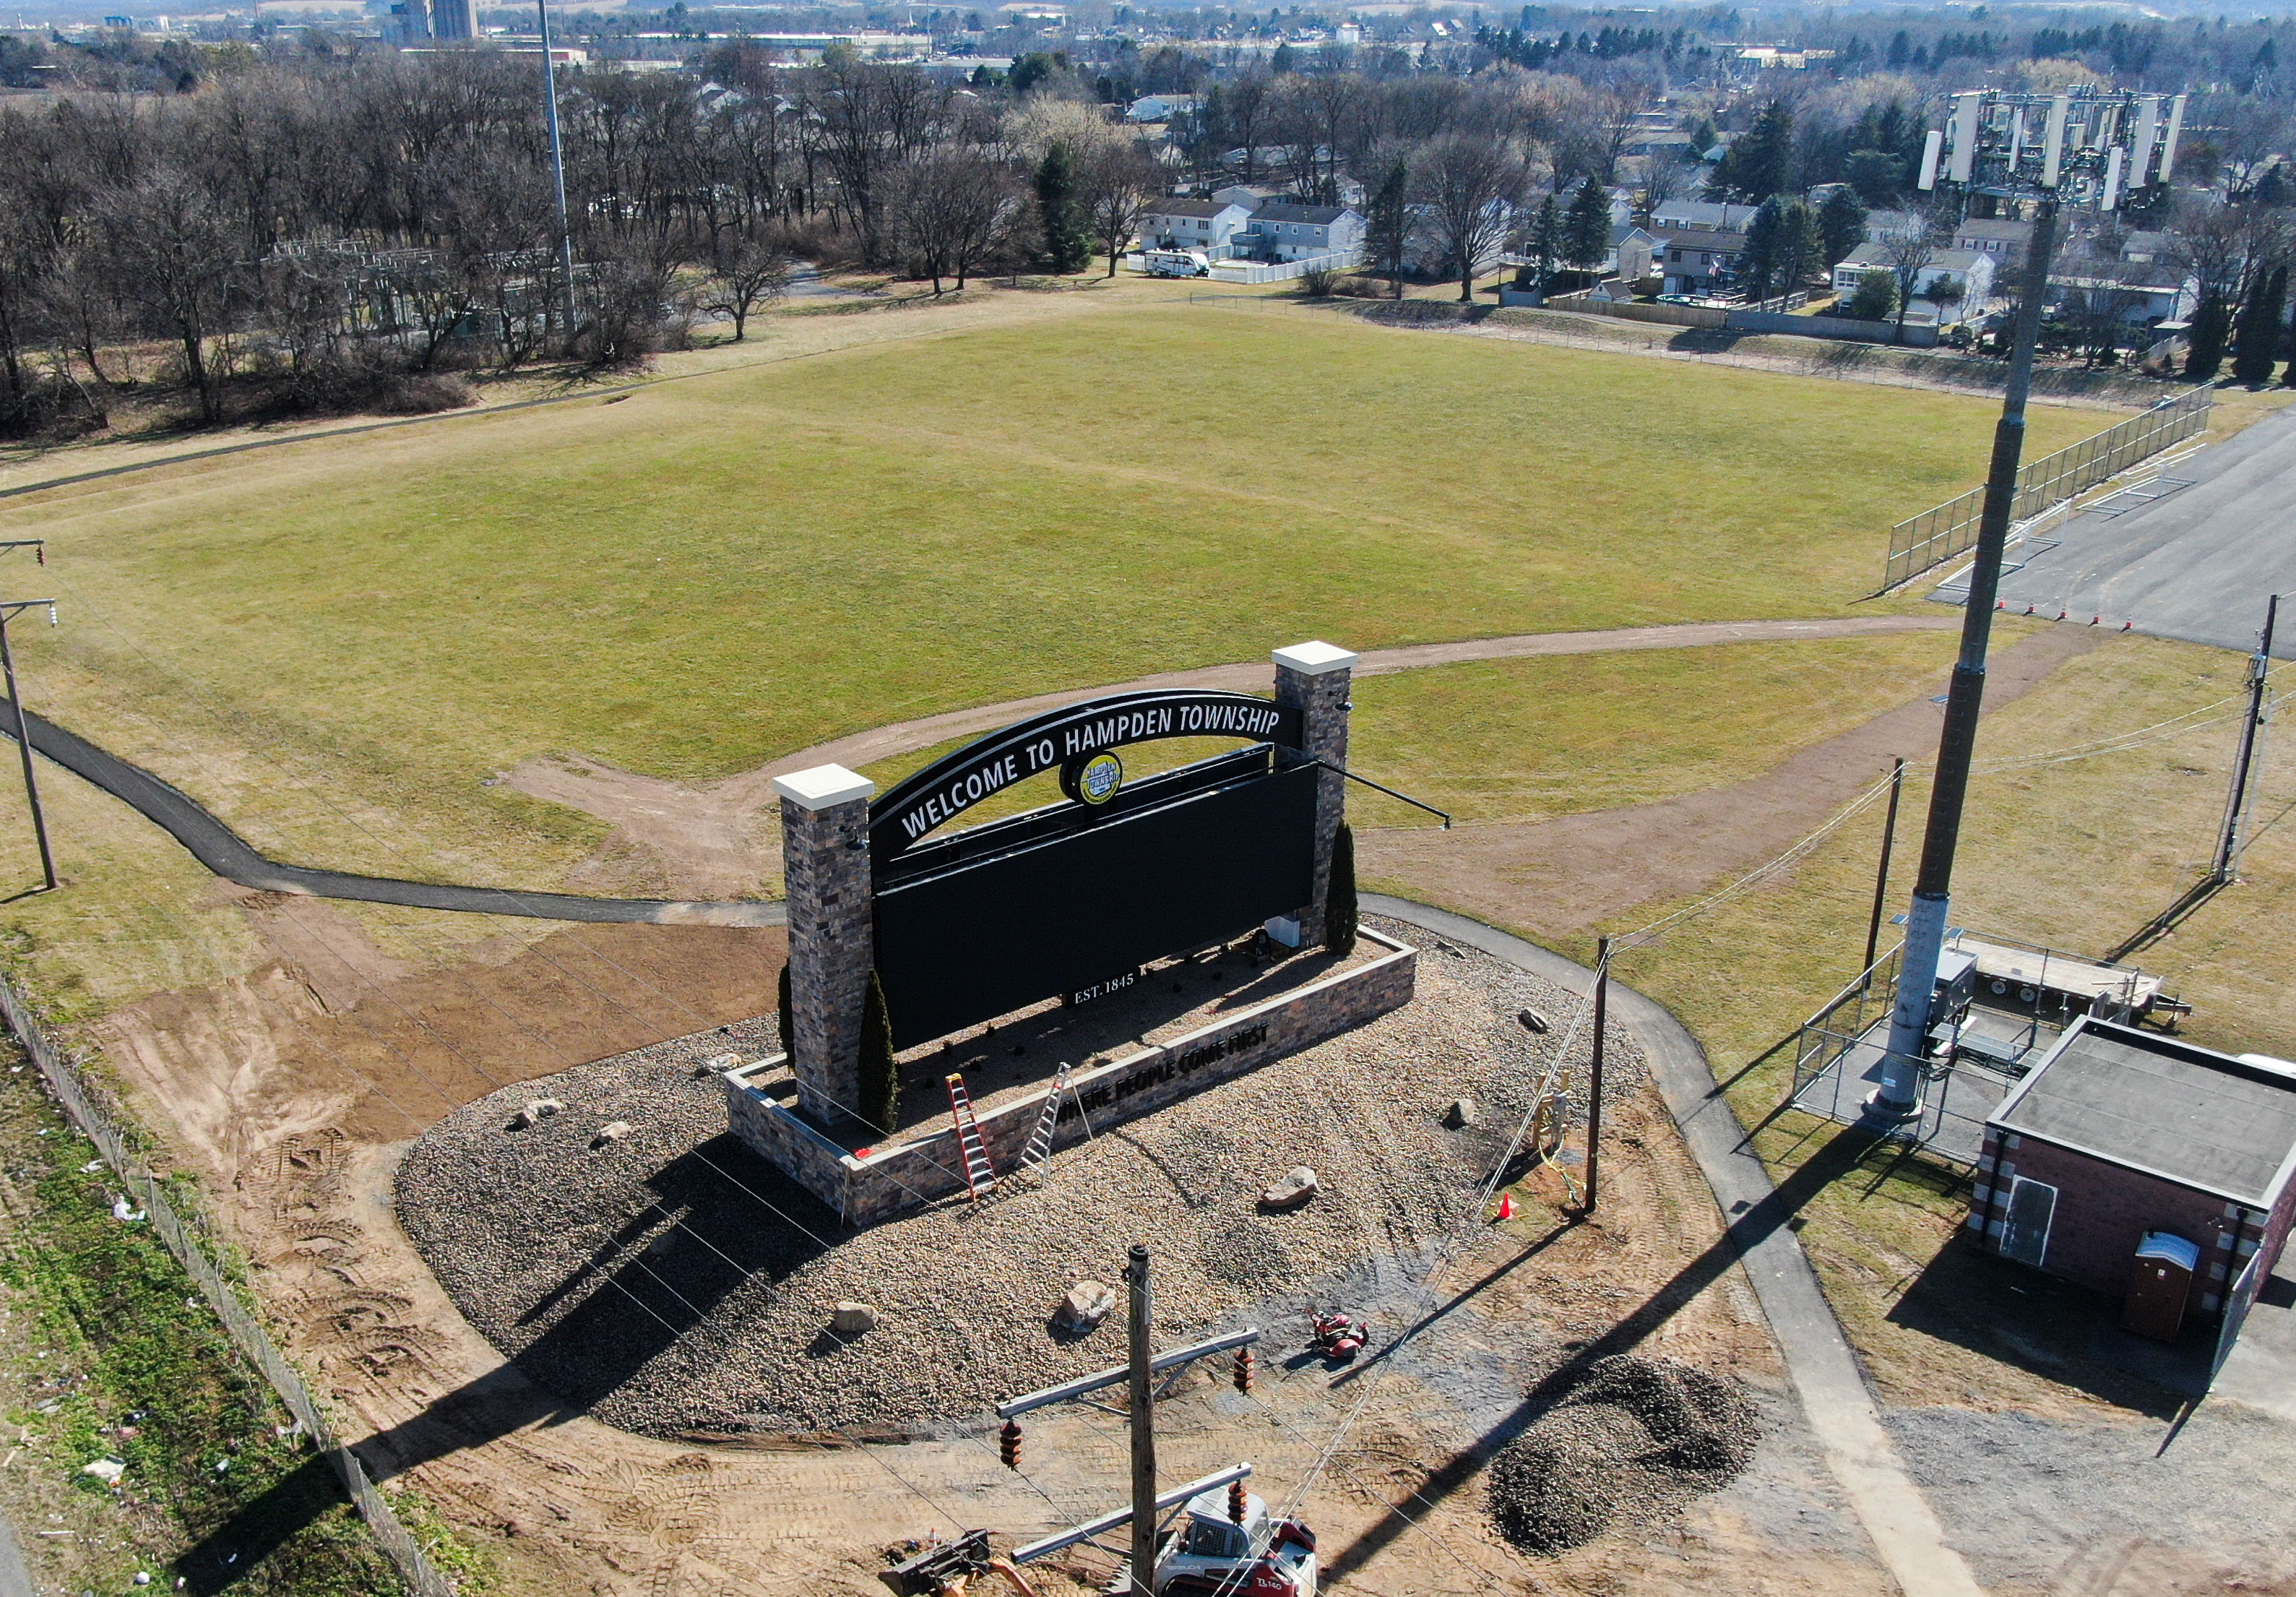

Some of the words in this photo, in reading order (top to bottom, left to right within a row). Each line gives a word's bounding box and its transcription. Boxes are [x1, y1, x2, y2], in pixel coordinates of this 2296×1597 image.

[902, 754, 1018, 838] WELCOME
[1026, 739, 1054, 770] TO
[1064, 707, 1172, 756] HAMPDEN
[1179, 705, 1279, 734] TOWNSHIP
[1116, 1059, 1175, 1100] PEOPLE
[1178, 1039, 1226, 1075] COME
[1228, 1023, 1269, 1055] FIRST
